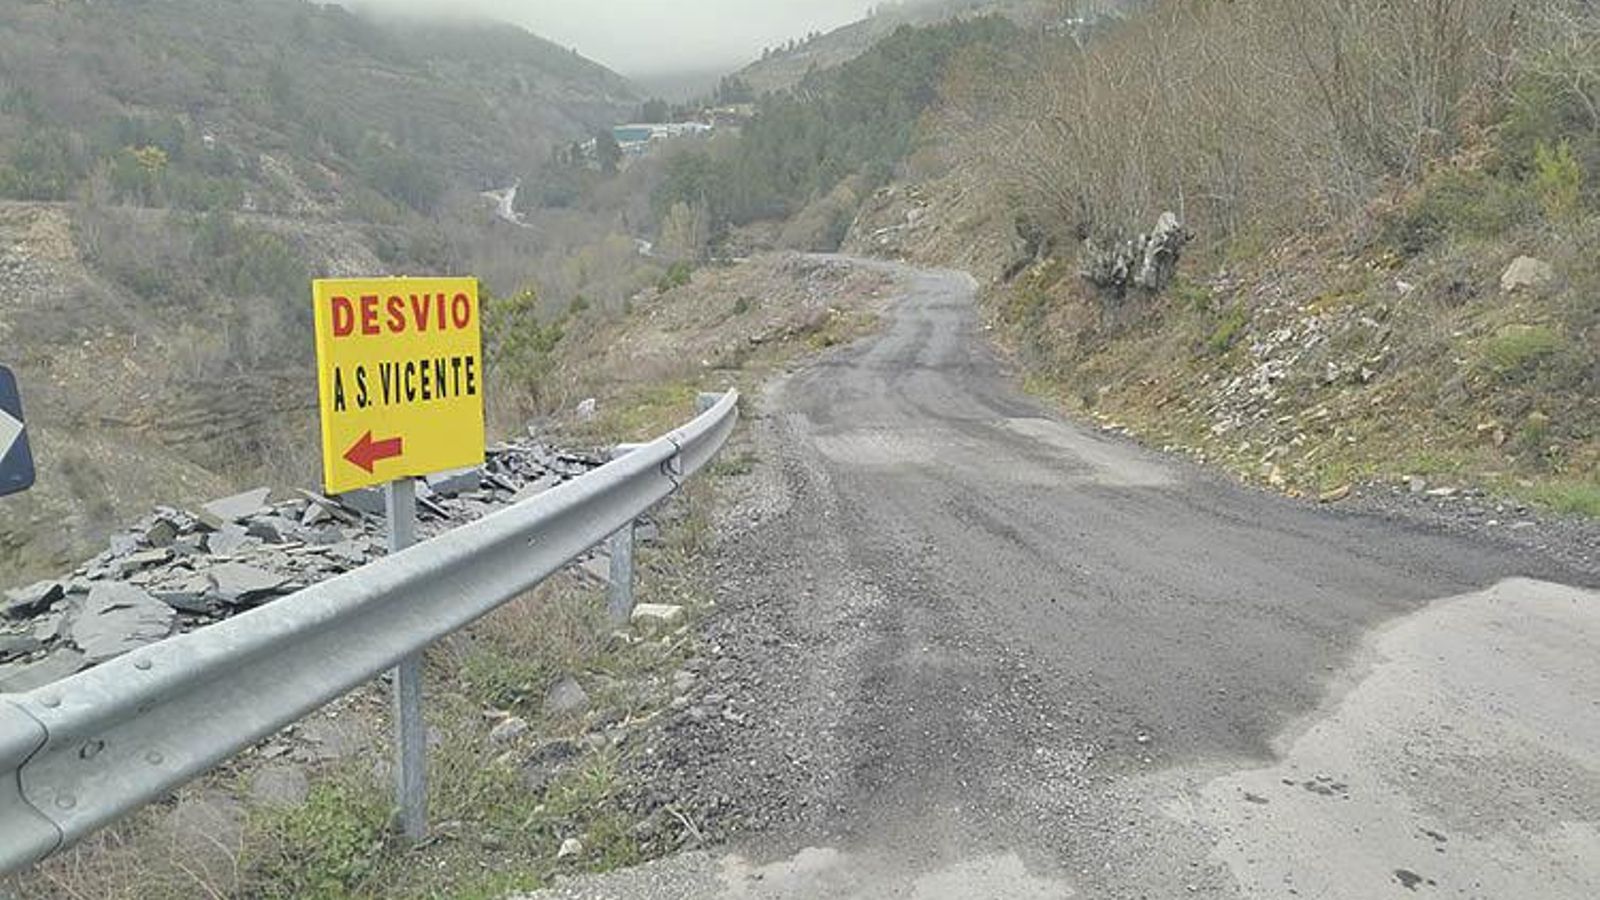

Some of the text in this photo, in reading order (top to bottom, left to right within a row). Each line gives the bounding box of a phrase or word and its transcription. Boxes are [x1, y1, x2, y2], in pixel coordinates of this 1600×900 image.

[331, 293, 470, 337] DESVIO
[334, 356, 476, 412] A S. VICENTE
